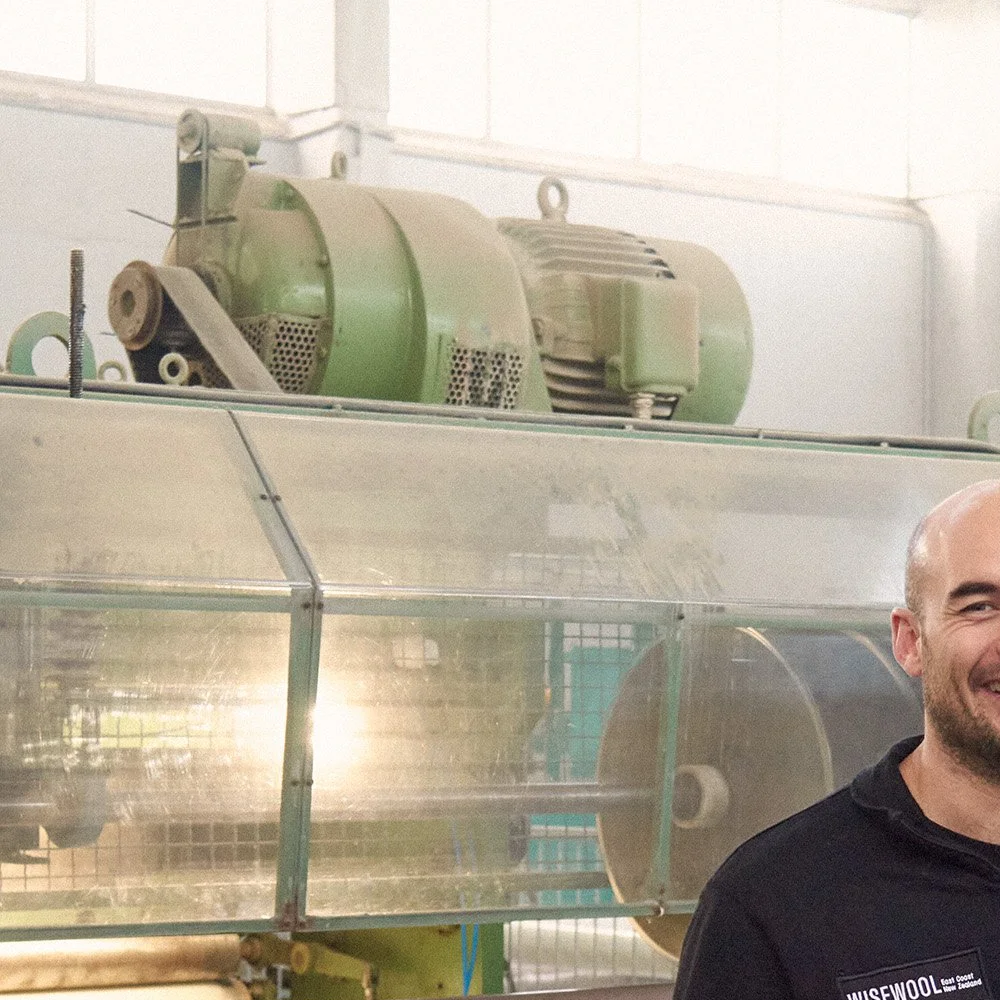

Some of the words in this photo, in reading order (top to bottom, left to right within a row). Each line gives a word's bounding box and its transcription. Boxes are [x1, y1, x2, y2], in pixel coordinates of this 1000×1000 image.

[941, 978, 955, 986] East
[956, 972, 974, 982] Coast
[958, 978, 982, 990] Zealand
